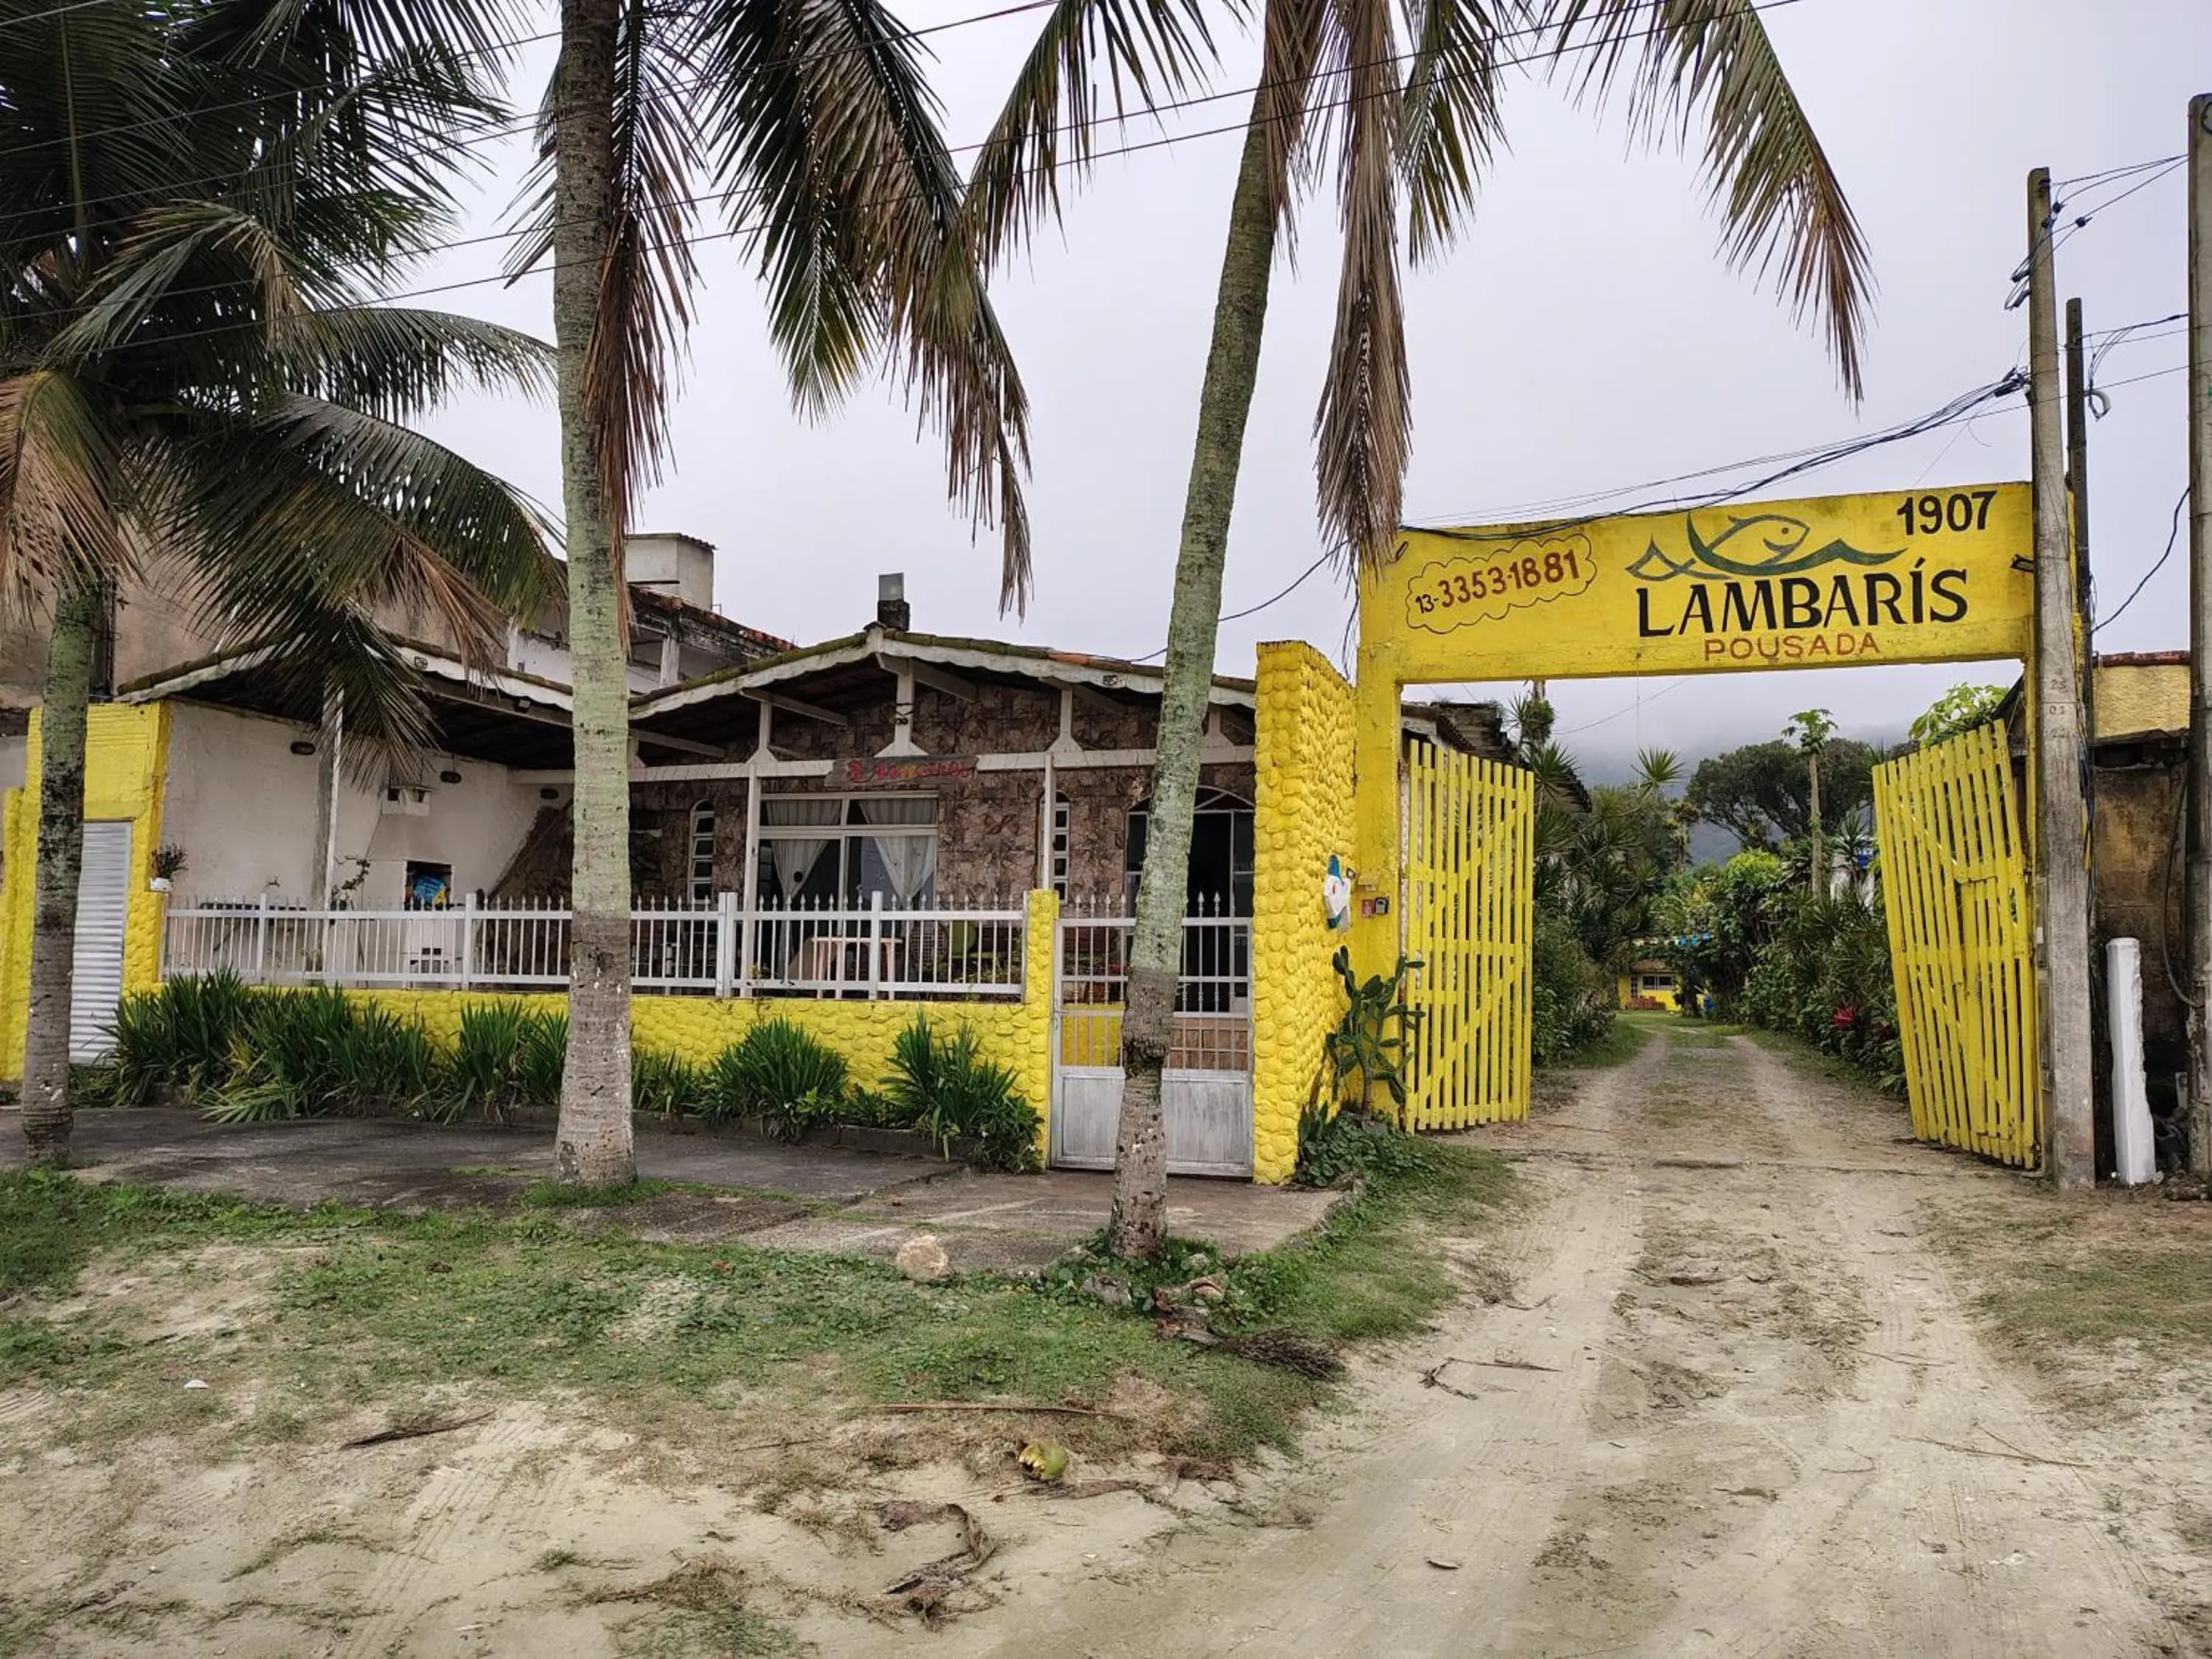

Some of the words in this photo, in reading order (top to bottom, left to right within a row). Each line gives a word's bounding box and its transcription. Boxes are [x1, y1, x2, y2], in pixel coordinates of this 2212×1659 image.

[1897, 490, 1997, 536] 1907
[1636, 557, 1969, 638] LAMBARÍS
[1704, 632, 1880, 661] POUSADA
